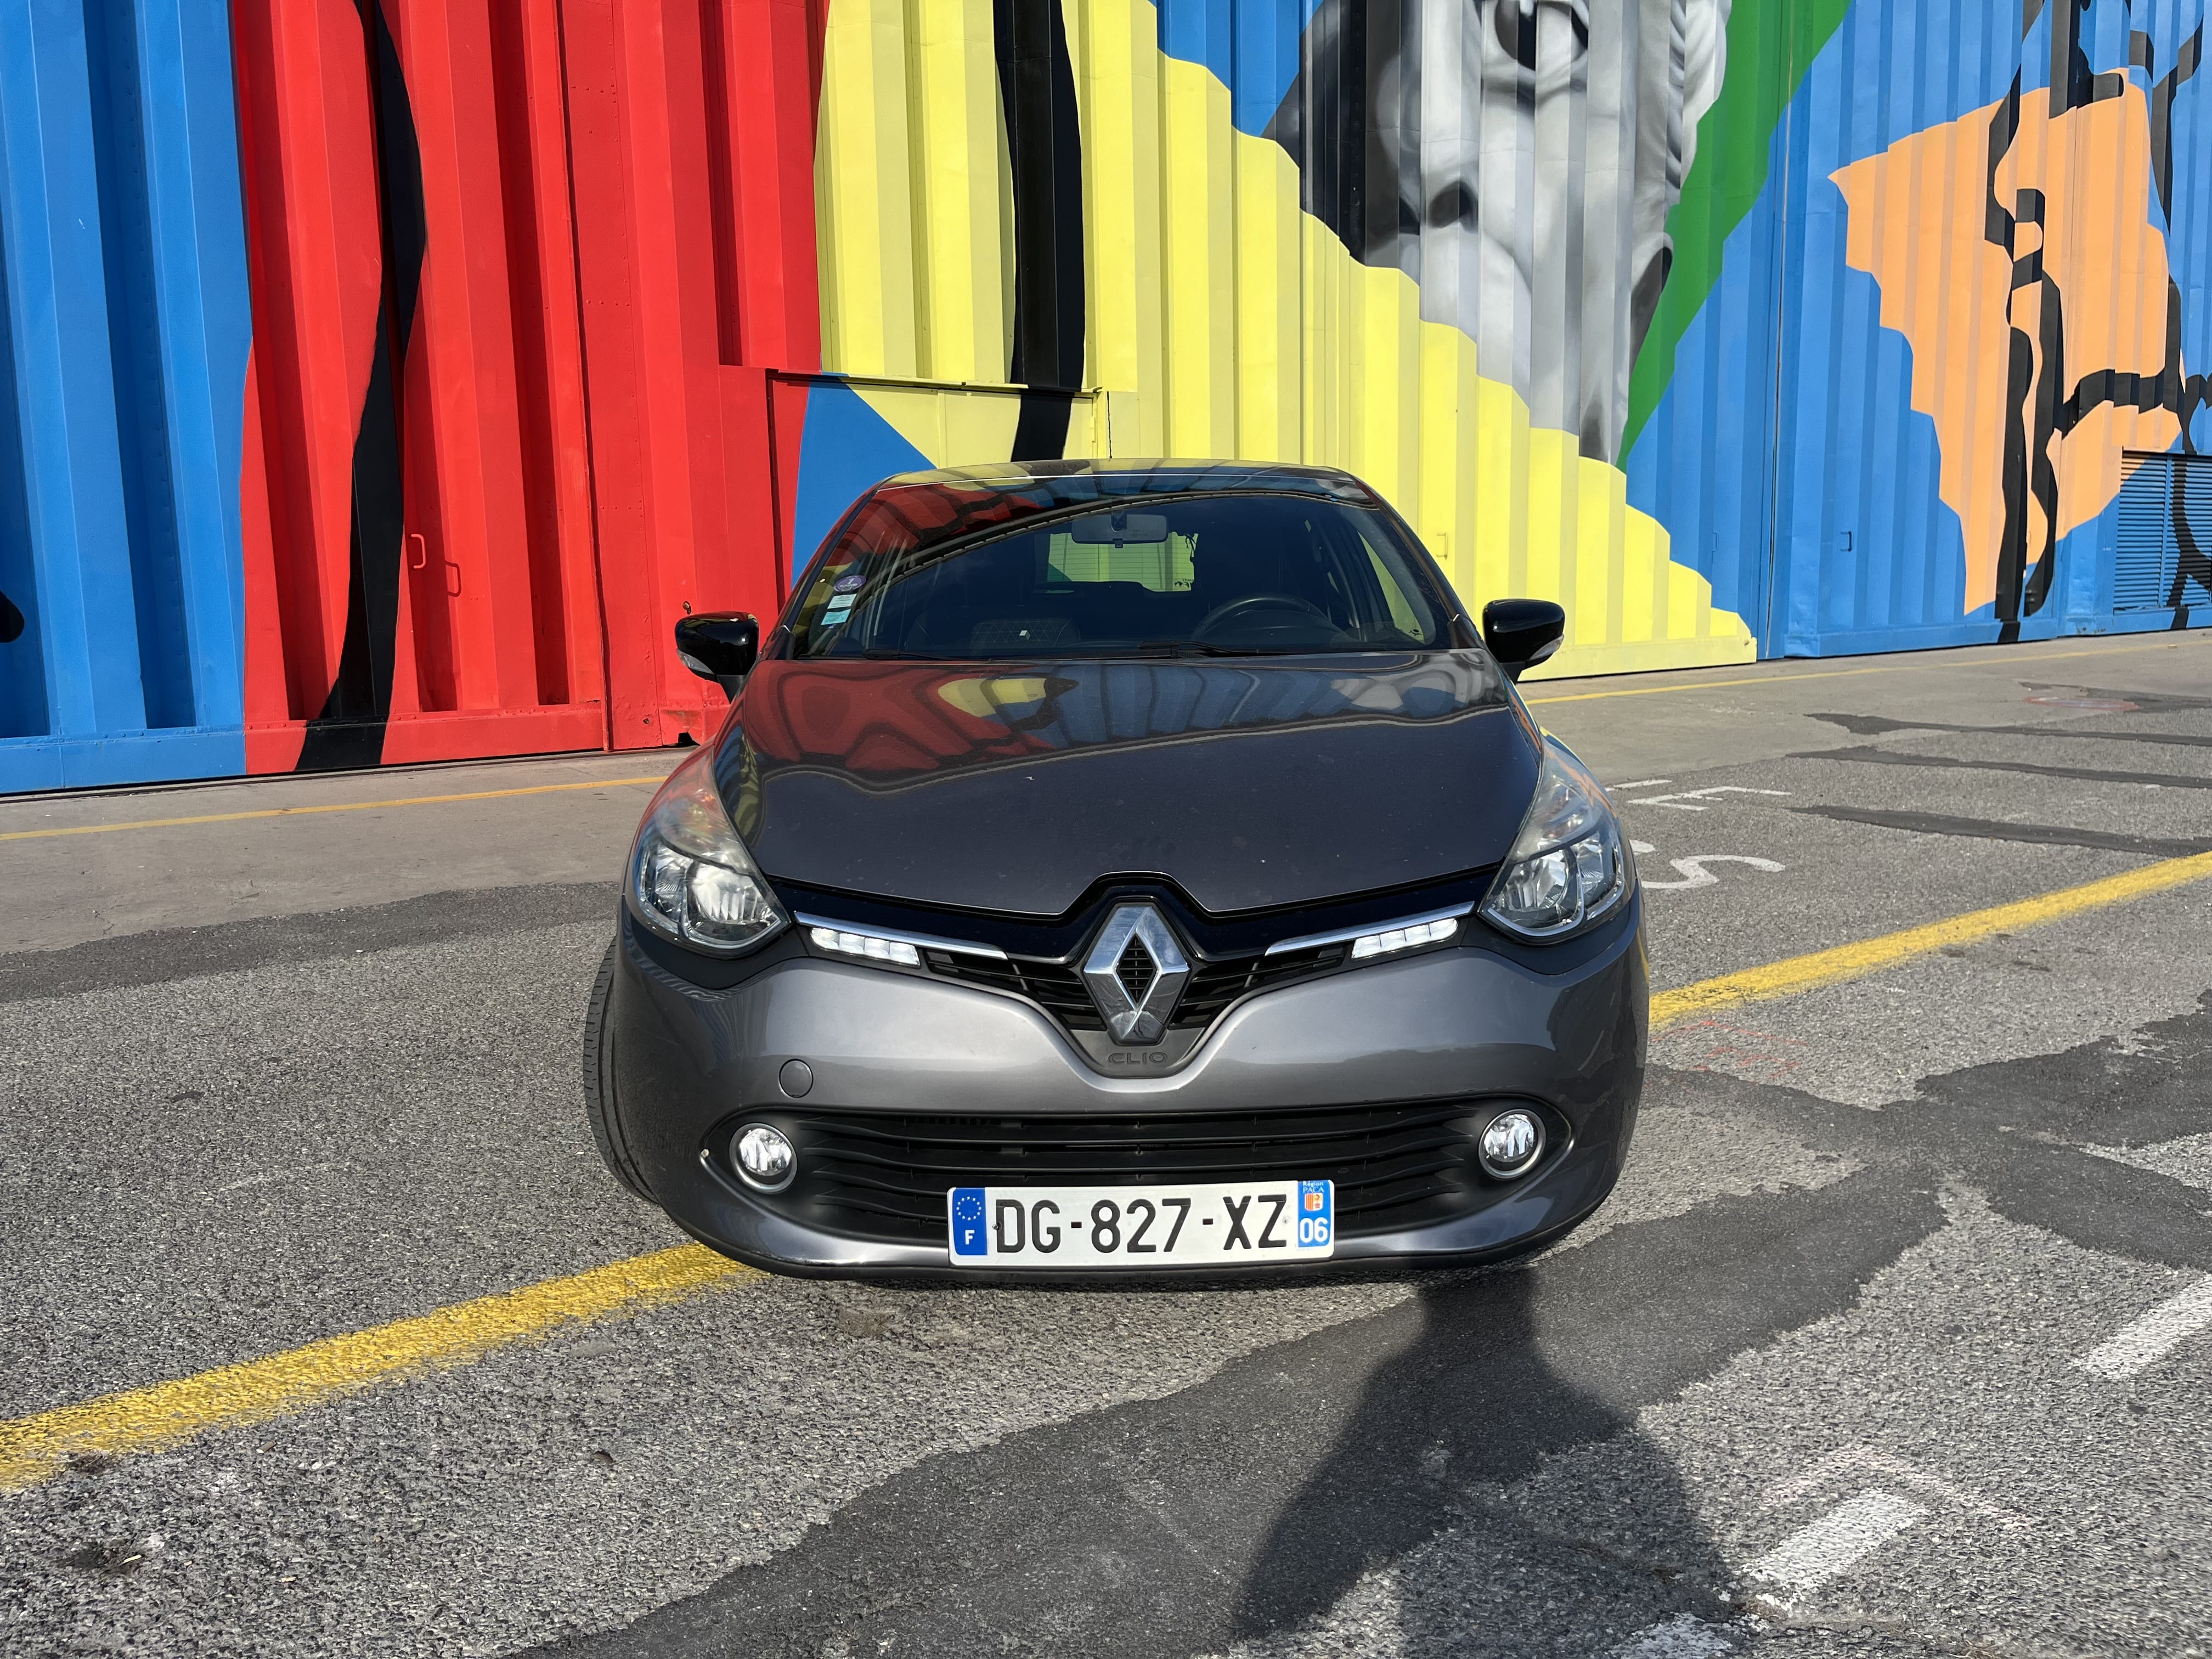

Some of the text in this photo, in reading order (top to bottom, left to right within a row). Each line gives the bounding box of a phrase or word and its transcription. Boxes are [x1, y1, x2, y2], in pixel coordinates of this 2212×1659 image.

[1108, 1052, 1167, 1064] CLIO
[995, 1194, 1287, 1254] DG-827-XZ
[1300, 1217, 1328, 1243] 06
[964, 1230, 975, 1245] F
